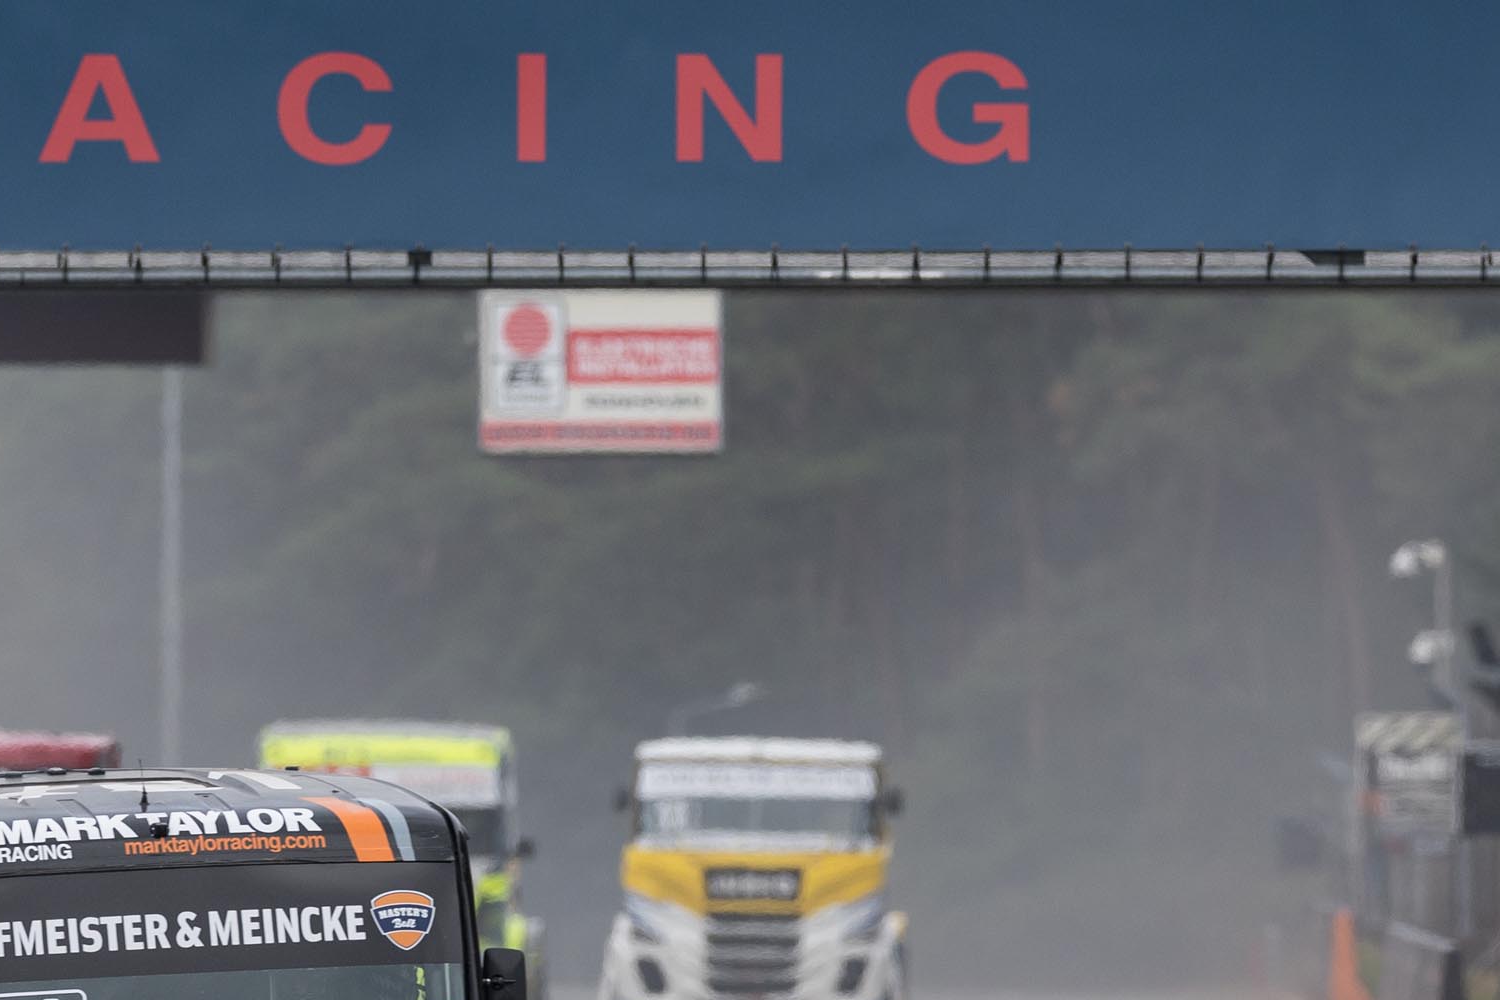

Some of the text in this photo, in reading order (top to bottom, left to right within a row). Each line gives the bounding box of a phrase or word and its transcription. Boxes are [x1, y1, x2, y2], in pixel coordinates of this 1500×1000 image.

[137, 808, 322, 838] TAYLOR
[124, 833, 326, 856] marktaylorracing.com
[174, 911, 203, 949] &
[208, 904, 367, 948] MEINCKE
